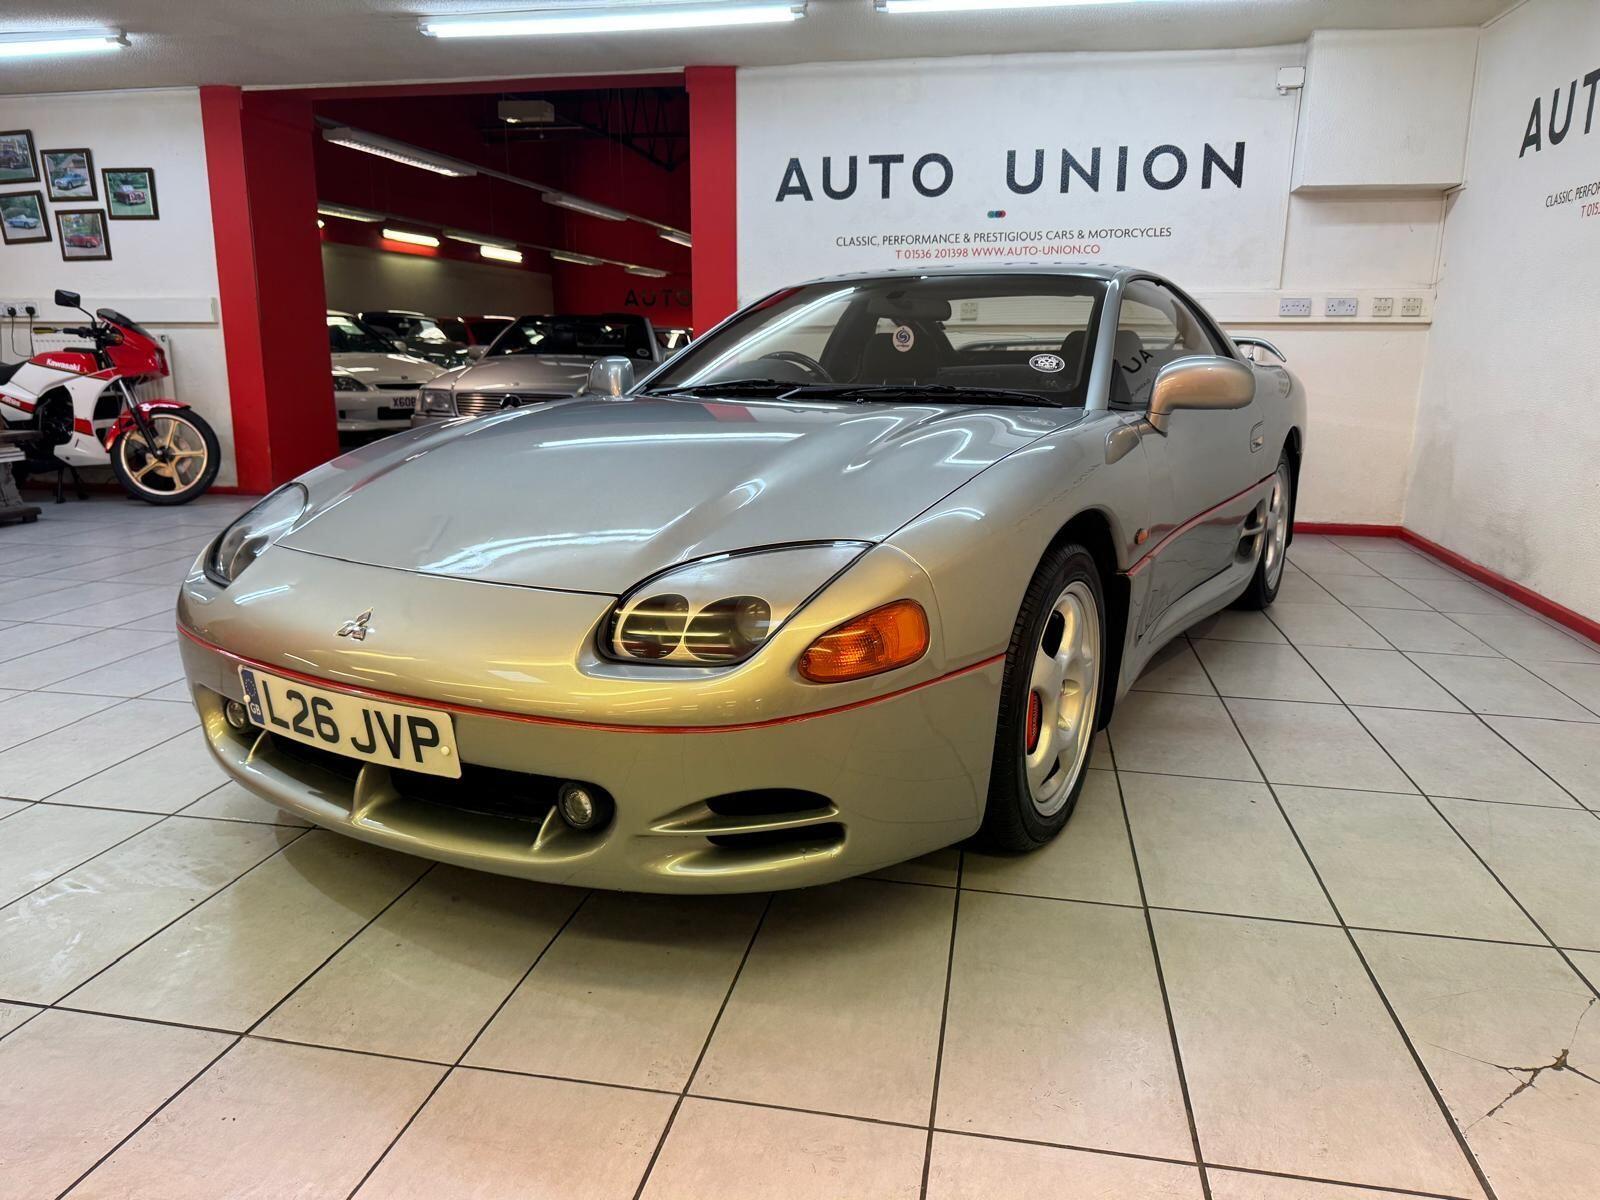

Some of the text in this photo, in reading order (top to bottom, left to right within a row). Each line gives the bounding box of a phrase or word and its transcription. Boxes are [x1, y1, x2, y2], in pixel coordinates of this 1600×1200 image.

[776, 141, 1246, 202] AUTO UNION
[1545, 189, 1573, 208] CLASSIC,
[1581, 204, 1587, 219] T
[836, 227, 1172, 247] CLASSIC, PERFORMANCE & PRESTIGIOUS CARS & MOTORCYCLES
[895, 244, 1101, 260] T 01536 201398 WWW.AUTO-UNION.CO
[46, 358, 81, 371] Kawasaki
[250, 702, 261, 715] GB
[262, 680, 440, 763] L26 JVP
